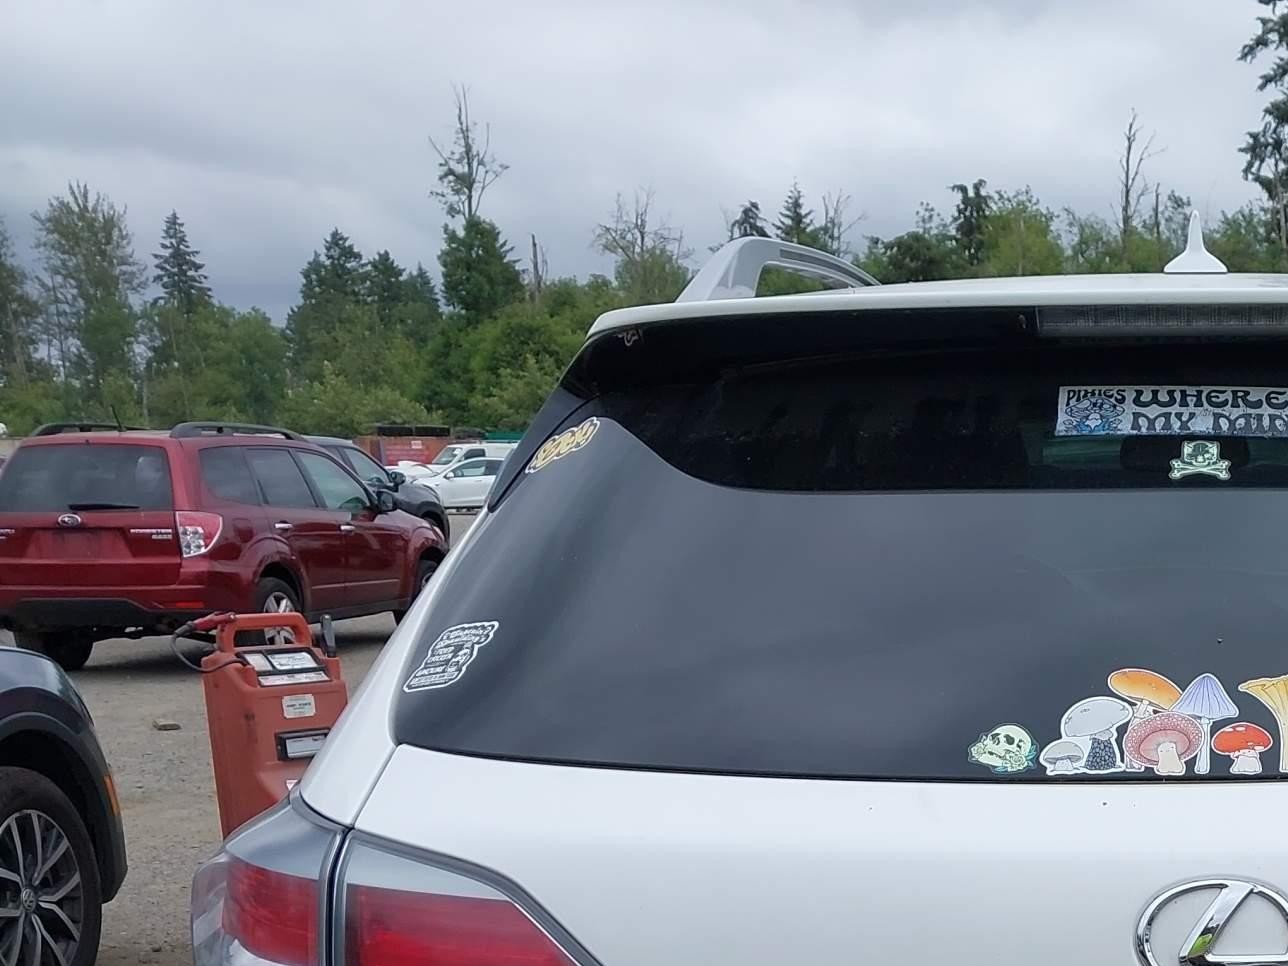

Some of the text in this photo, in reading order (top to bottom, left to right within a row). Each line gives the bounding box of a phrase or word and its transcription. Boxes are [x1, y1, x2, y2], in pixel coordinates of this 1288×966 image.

[1065, 388, 1127, 407] PIXIES
[1132, 388, 1288, 410] WHERE
[1130, 411, 1196, 432] MY
